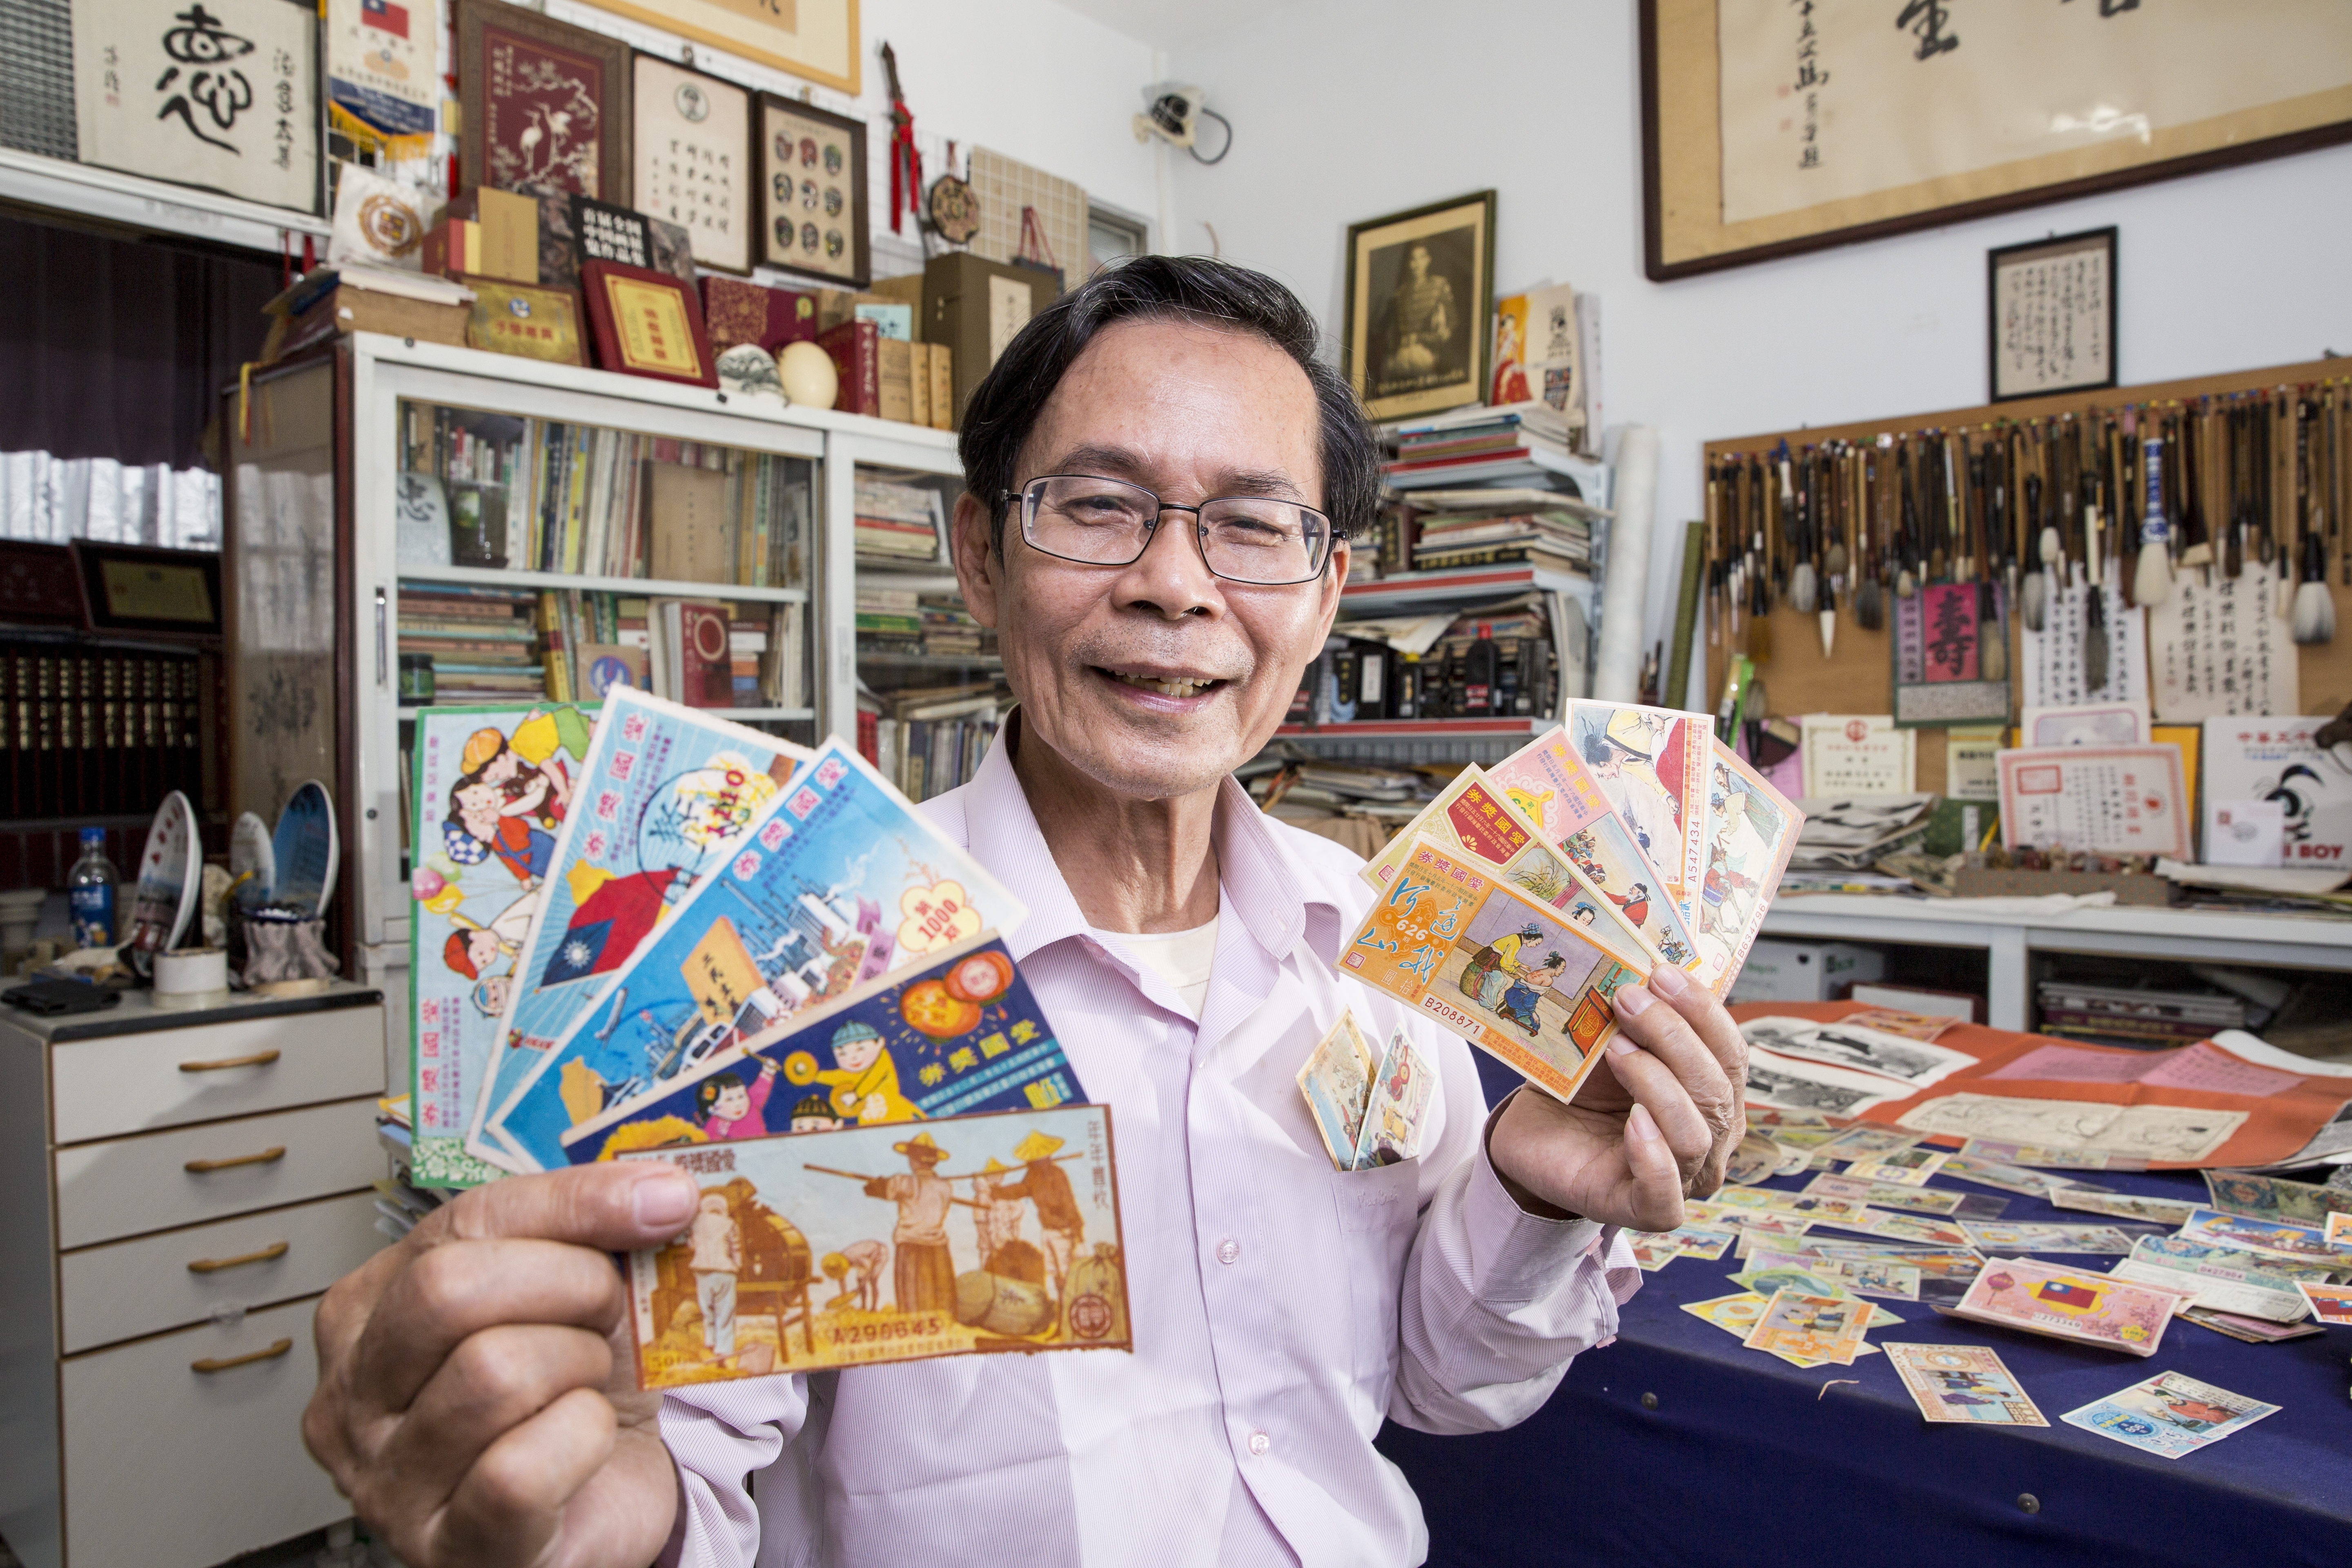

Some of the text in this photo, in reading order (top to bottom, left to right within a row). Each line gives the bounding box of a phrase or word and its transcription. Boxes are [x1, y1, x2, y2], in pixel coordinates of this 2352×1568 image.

[1551, 743, 1600, 811] 愛國獎券
[1467, 789, 1525, 848] 愛國獎券
[1527, 801, 1535, 809] 第
[1418, 851, 1484, 892] 愛國獎券
[1688, 820, 1700, 882] A547434
[2299, 844, 2343, 859] BOY
[918, 899, 958, 940] 1000
[1396, 919, 1428, 940] 626
[1737, 903, 1766, 958] B634796
[1424, 997, 1481, 1034] B208871
